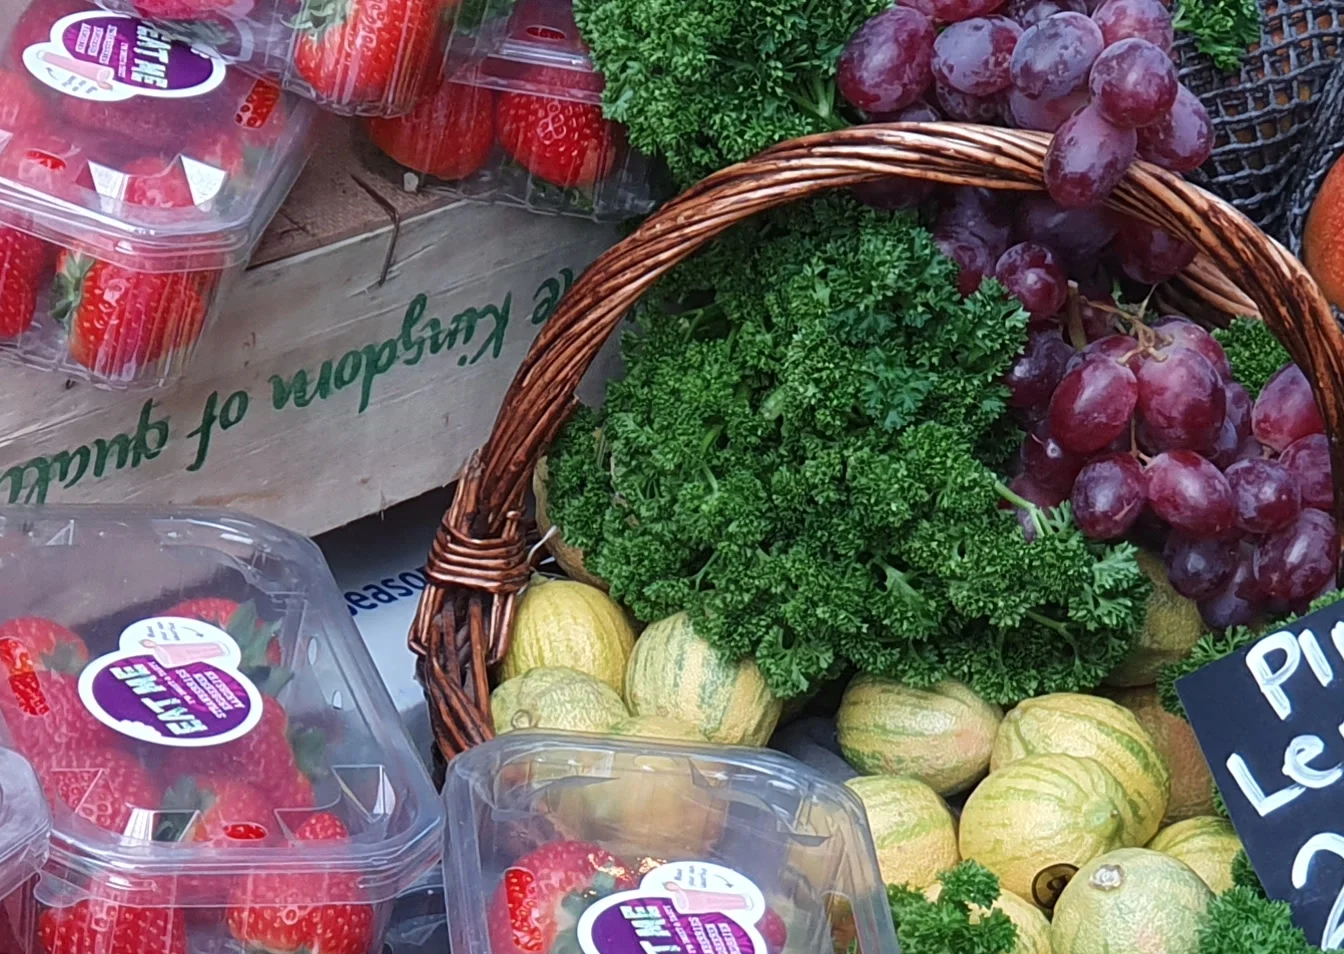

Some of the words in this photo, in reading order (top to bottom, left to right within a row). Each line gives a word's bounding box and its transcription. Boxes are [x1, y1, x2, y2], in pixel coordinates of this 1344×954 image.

[131, 59, 169, 89] ME
[531, 267, 574, 325] e
[271, 293, 513, 413] Kingdom
[186, 390, 250, 471] of
[344, 565, 428, 617] easo
[109, 663, 167, 695] ME
[140, 696, 208, 736] EAT
[618, 905, 672, 938] ME
